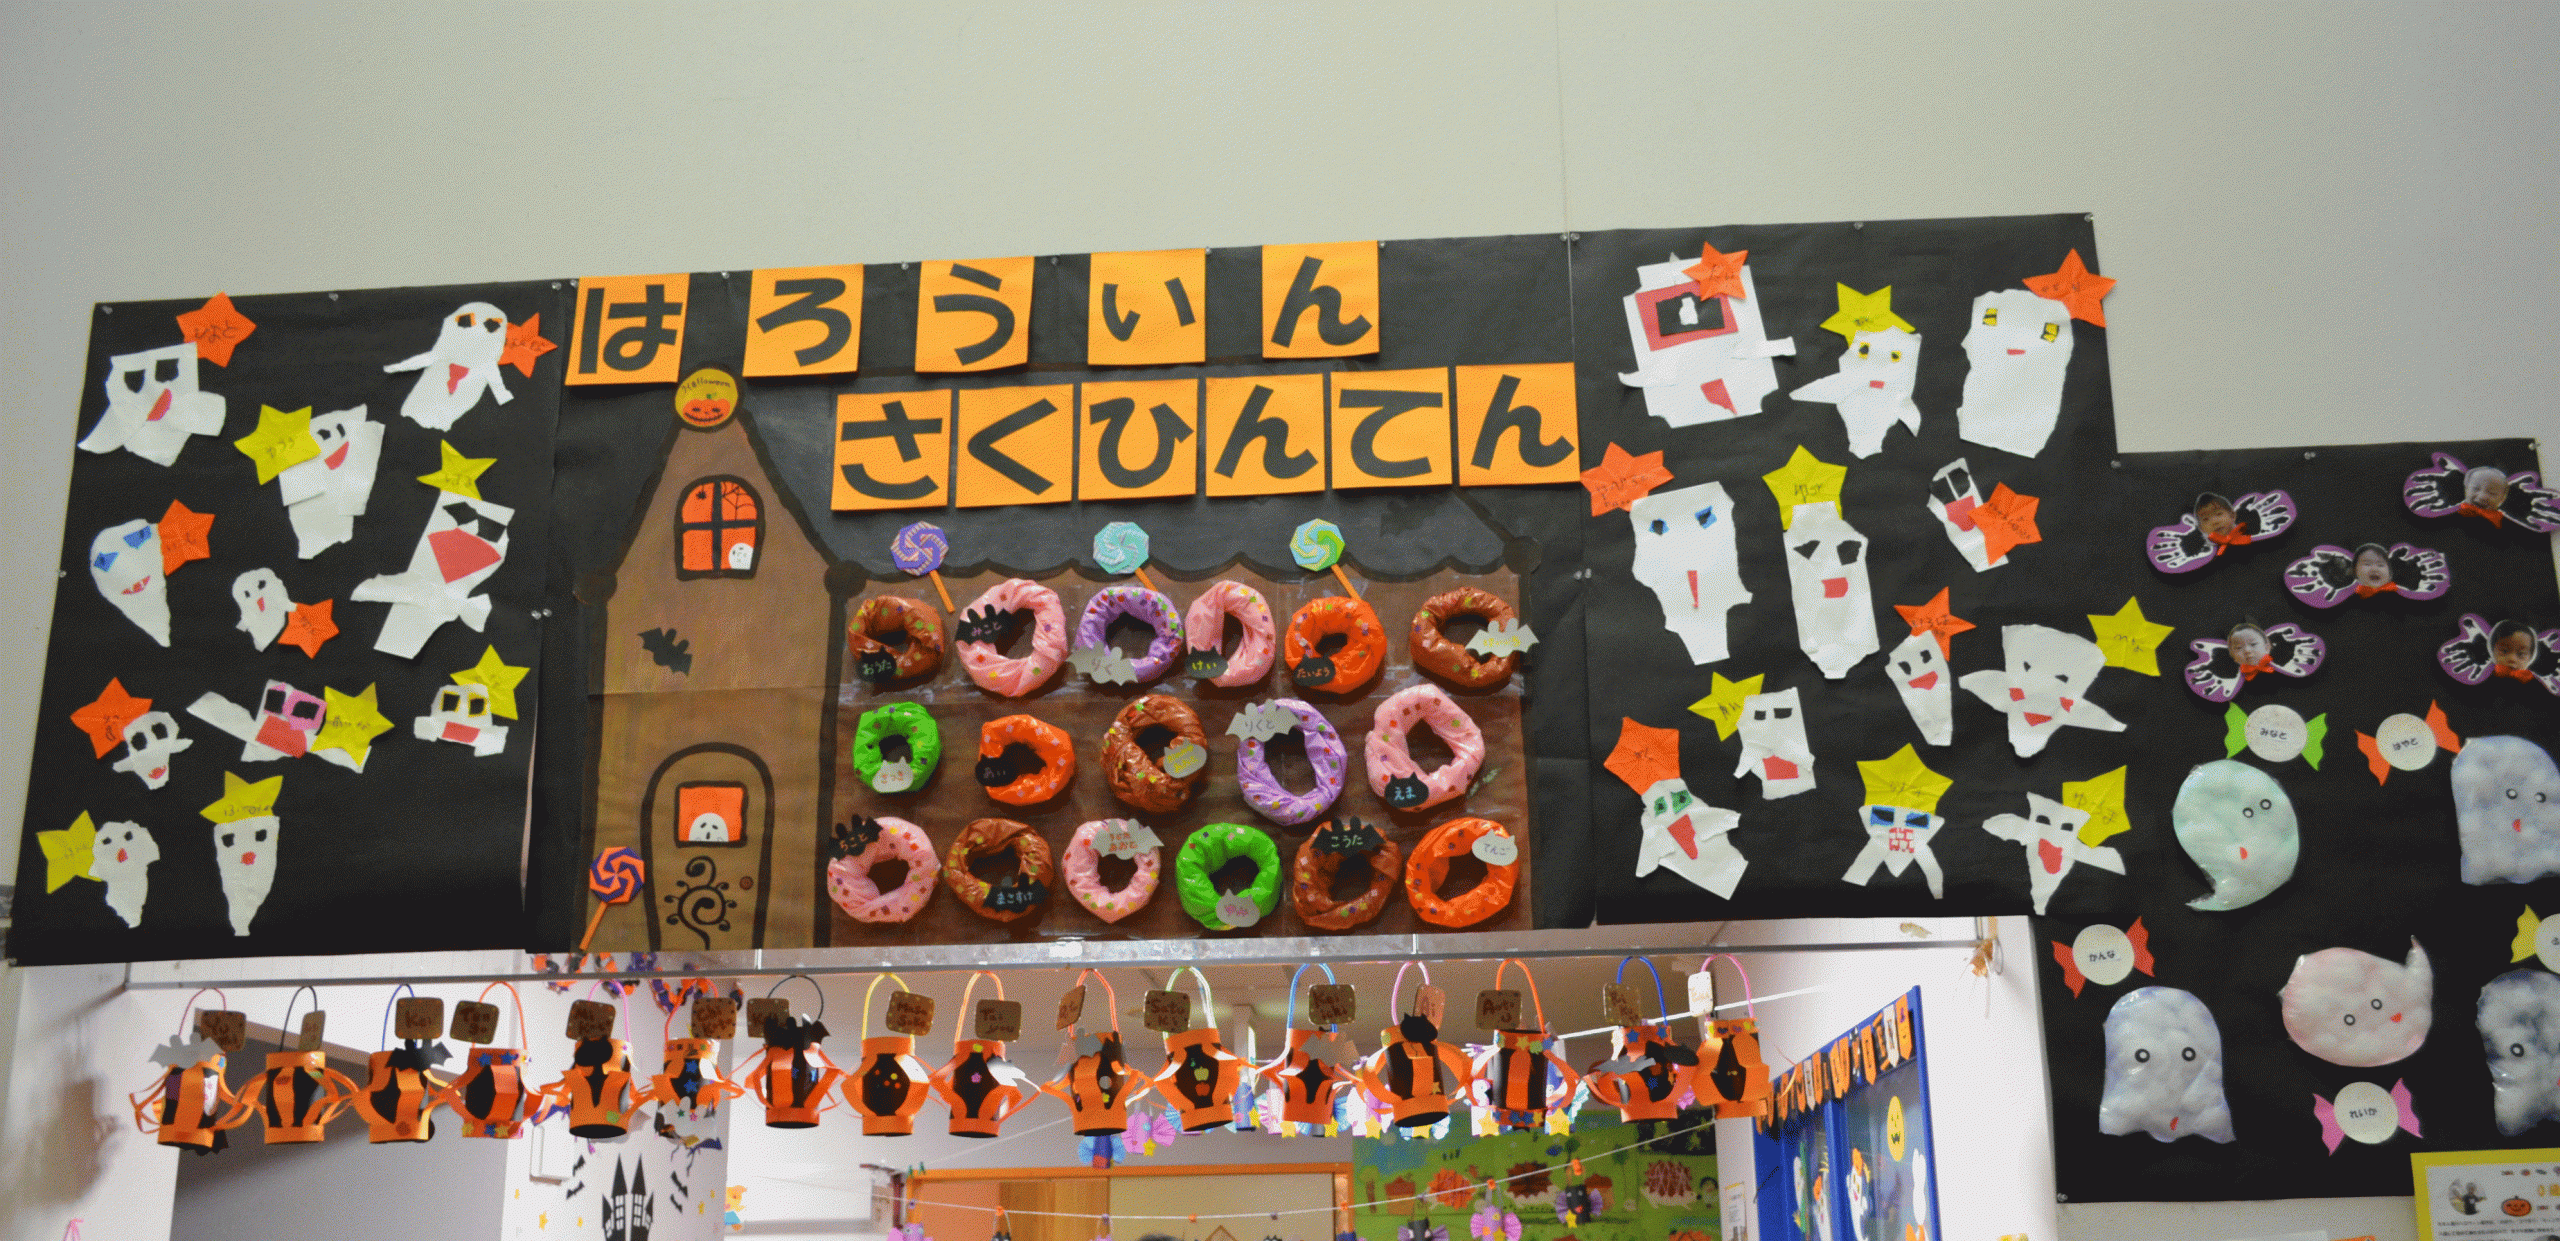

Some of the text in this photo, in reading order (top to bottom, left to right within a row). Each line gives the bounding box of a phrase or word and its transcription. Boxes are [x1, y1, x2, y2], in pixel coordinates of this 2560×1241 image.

[578, 255, 1373, 375] はろういん
[840, 373, 1576, 501] さくひんてん
